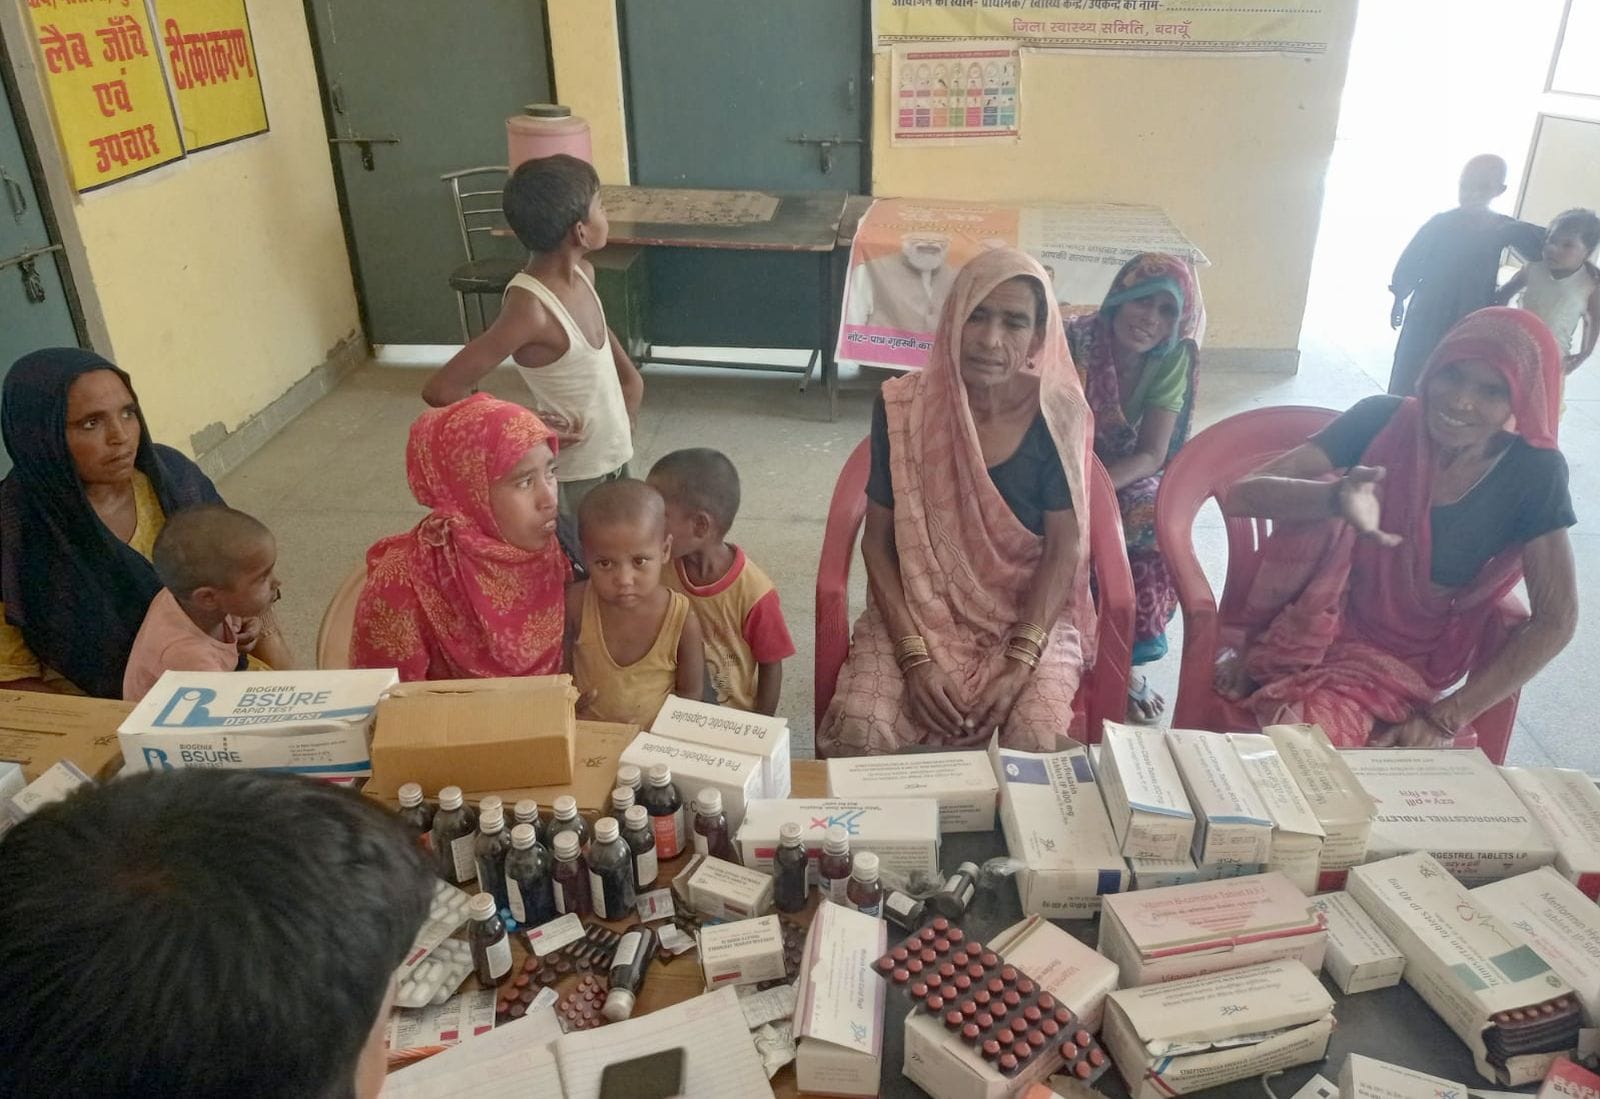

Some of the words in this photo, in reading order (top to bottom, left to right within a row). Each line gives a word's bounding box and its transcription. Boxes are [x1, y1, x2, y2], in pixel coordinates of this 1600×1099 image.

[1012, 18, 1045, 32] जिला
[1050, 21, 1097, 34] स्वास्थ्य
[1101, 20, 1149, 36] समिति,
[39, 24, 94, 74] लैब
[164, 18, 254, 91] टीकाकरण
[93, 67, 134, 117] एवं
[89, 123, 161, 173] उपचार
[246, 685, 296, 693] BIOGENIX
[236, 690, 332, 708] BSURE
[232, 706, 265, 714] RAPID
[267, 705, 294, 713] TEST
[670, 710, 708, 727] Capsules
[707, 717, 744, 735] Probiotic
[751, 727, 768, 739] Pre
[179, 743, 213, 751] BIOGENIX
[181, 750, 242, 763] BSURE
[679, 750, 717, 766] Probiotic
[725, 761, 741, 772] Pre
[1062, 790, 1072, 804] 400
[1066, 804, 1074, 816] mg
[1380, 815, 1426, 823] TABLETS
[1430, 852, 1474, 860] RGESTREL
[1477, 852, 1514, 860] TABLETS
[1387, 878, 1401, 890] mg
[1398, 891, 1412, 901] 40
